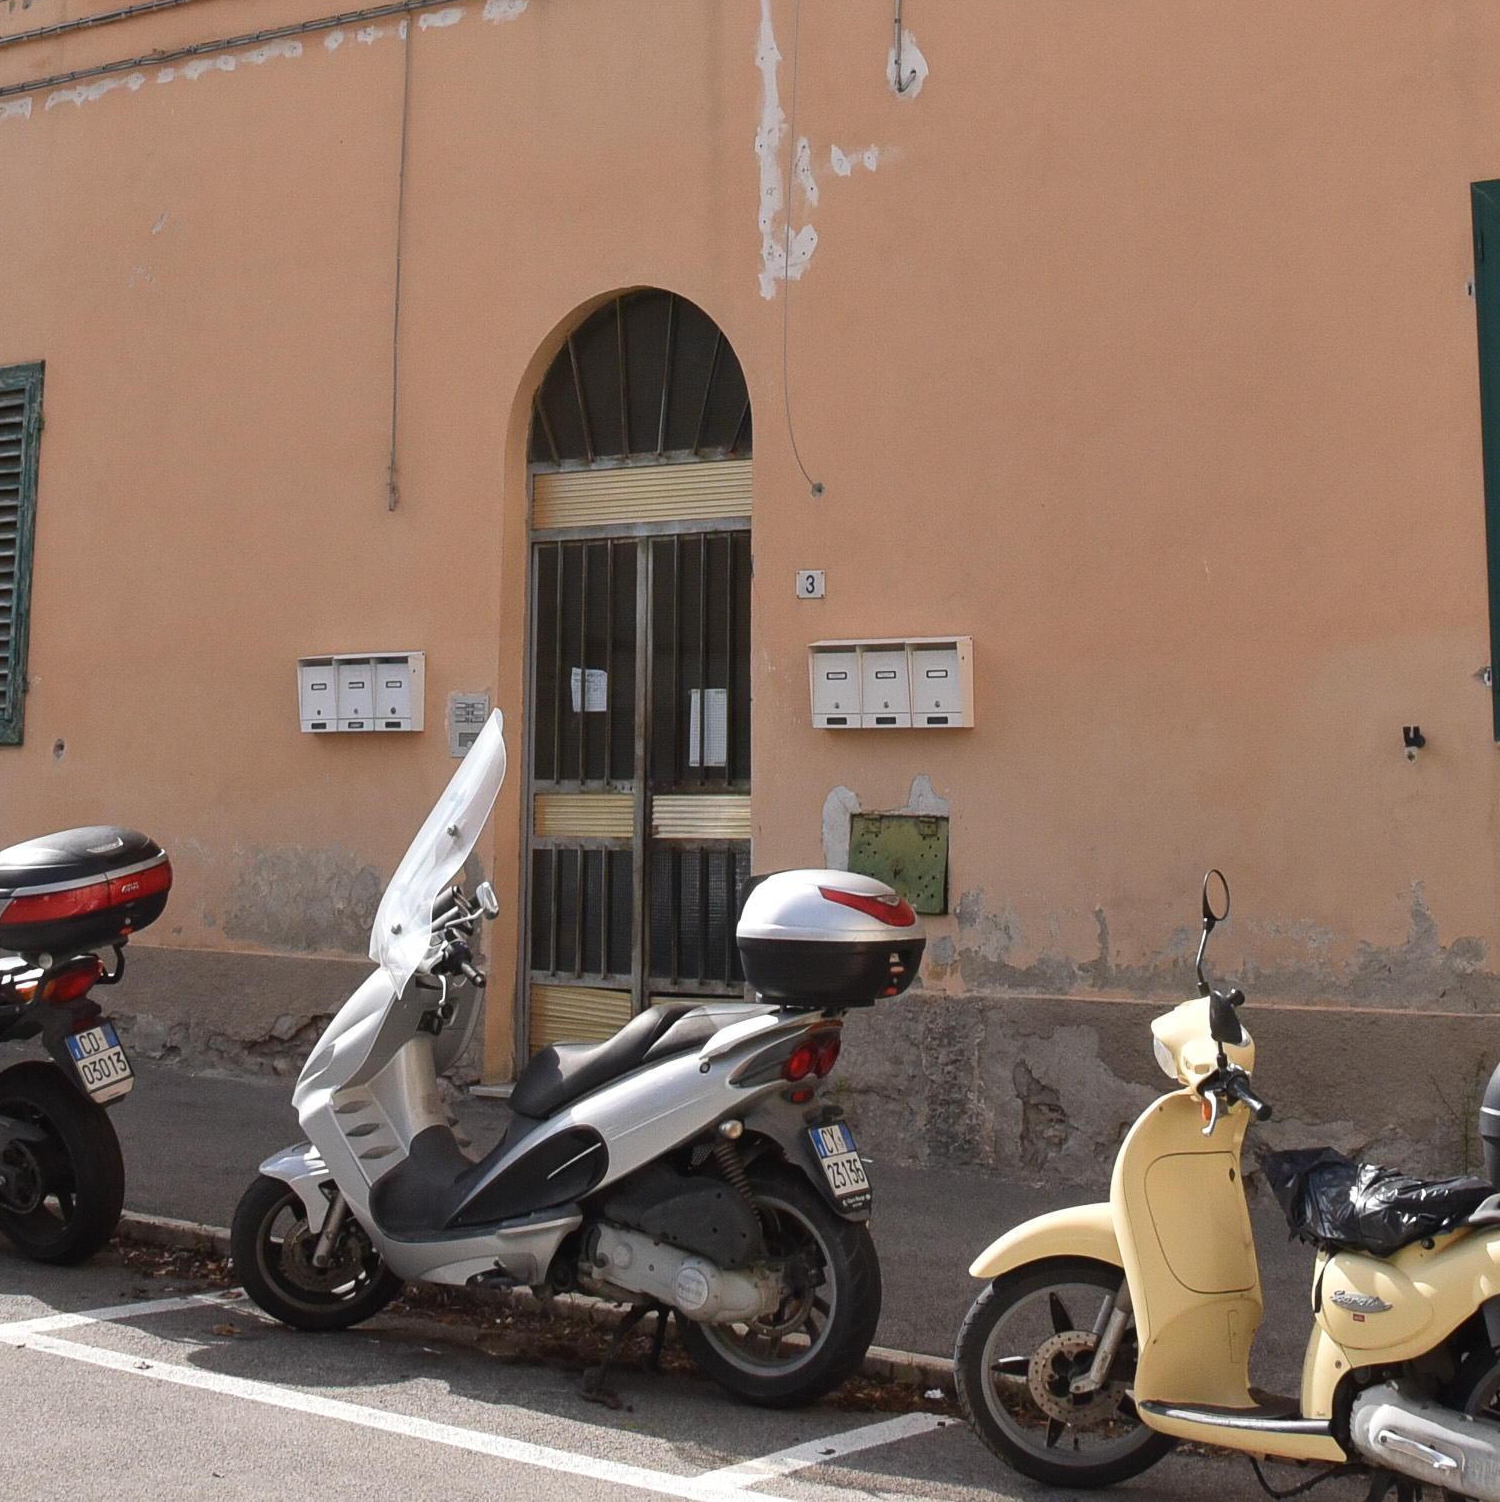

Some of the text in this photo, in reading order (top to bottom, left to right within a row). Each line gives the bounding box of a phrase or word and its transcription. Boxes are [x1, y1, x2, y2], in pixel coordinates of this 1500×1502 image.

[805, 574, 815, 594] 3
[79, 1032, 100, 1054] CD
[82, 1051, 127, 1085] 03013
[821, 1128, 839, 1153] CY
[827, 1159, 865, 1189] 23136
